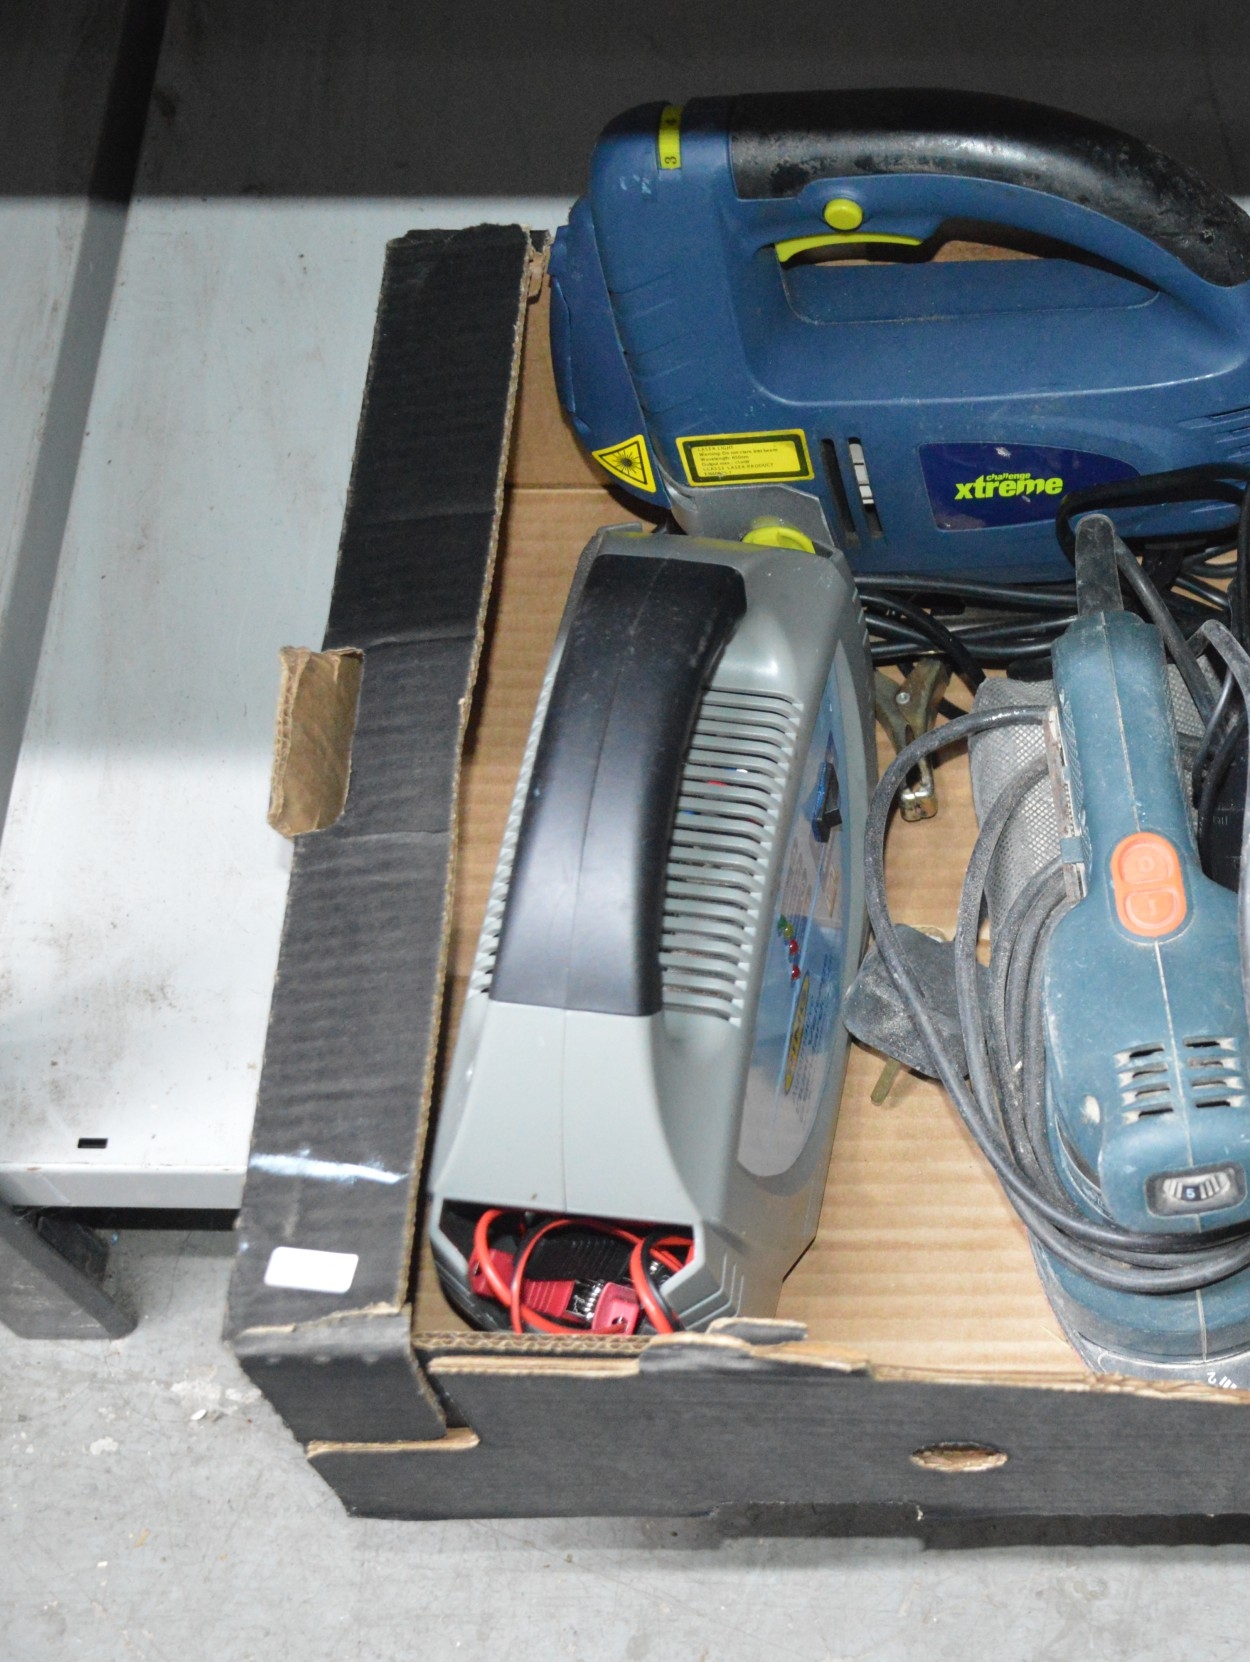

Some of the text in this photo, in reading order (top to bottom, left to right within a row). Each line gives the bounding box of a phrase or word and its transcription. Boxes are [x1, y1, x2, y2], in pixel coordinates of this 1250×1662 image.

[986, 472, 1031, 481] challenge
[954, 474, 1063, 500] xtreme
[1185, 1187, 1197, 1200] 5
